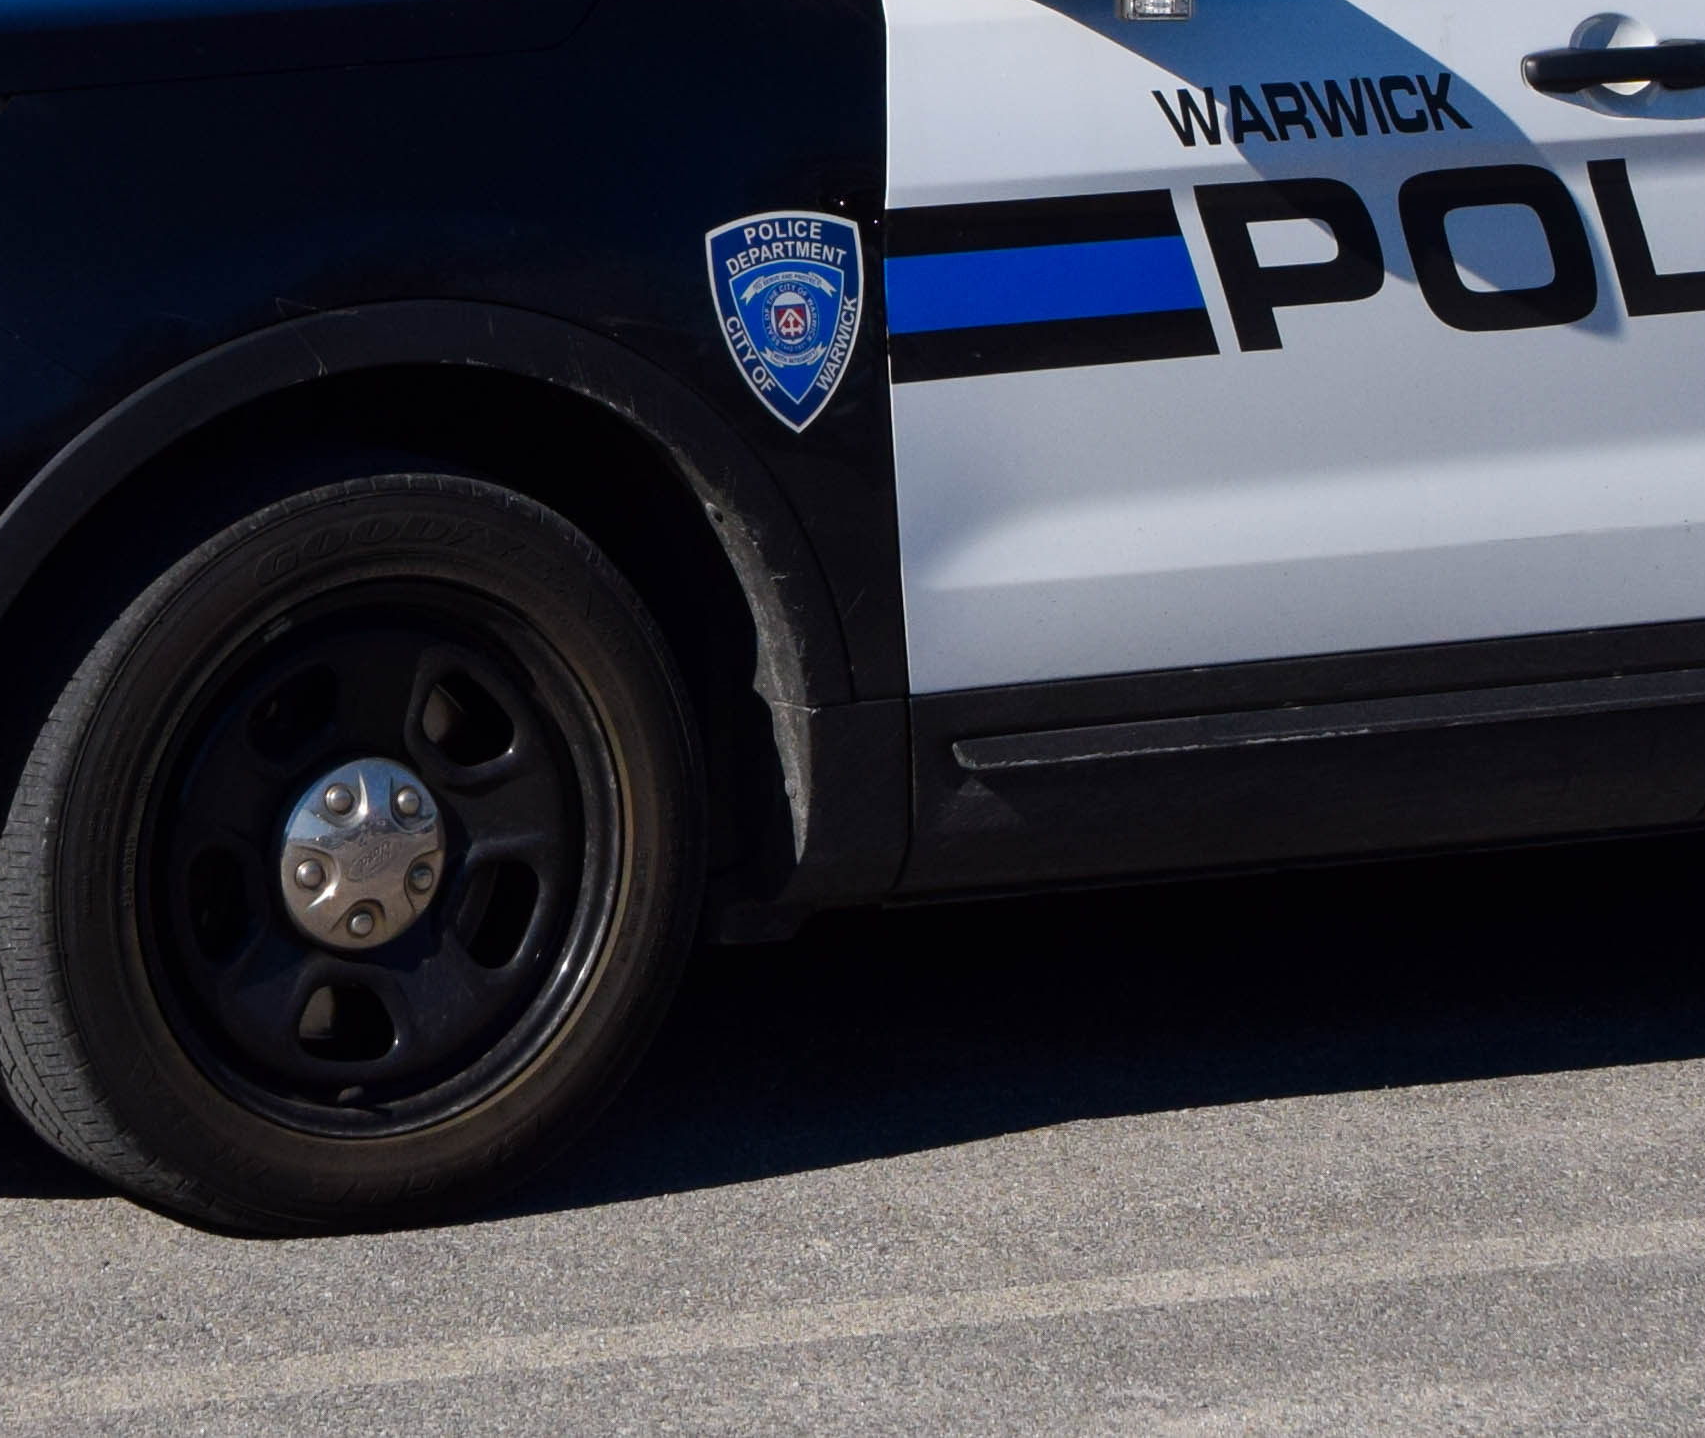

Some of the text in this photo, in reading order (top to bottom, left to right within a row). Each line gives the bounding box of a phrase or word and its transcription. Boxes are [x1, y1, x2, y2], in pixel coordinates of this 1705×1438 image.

[1151, 72, 1473, 148] WARWICK
[725, 241, 847, 276] DEPARTMENT
[744, 221, 823, 245] POLICE
[726, 296, 858, 392] CITY OF WARWICK
